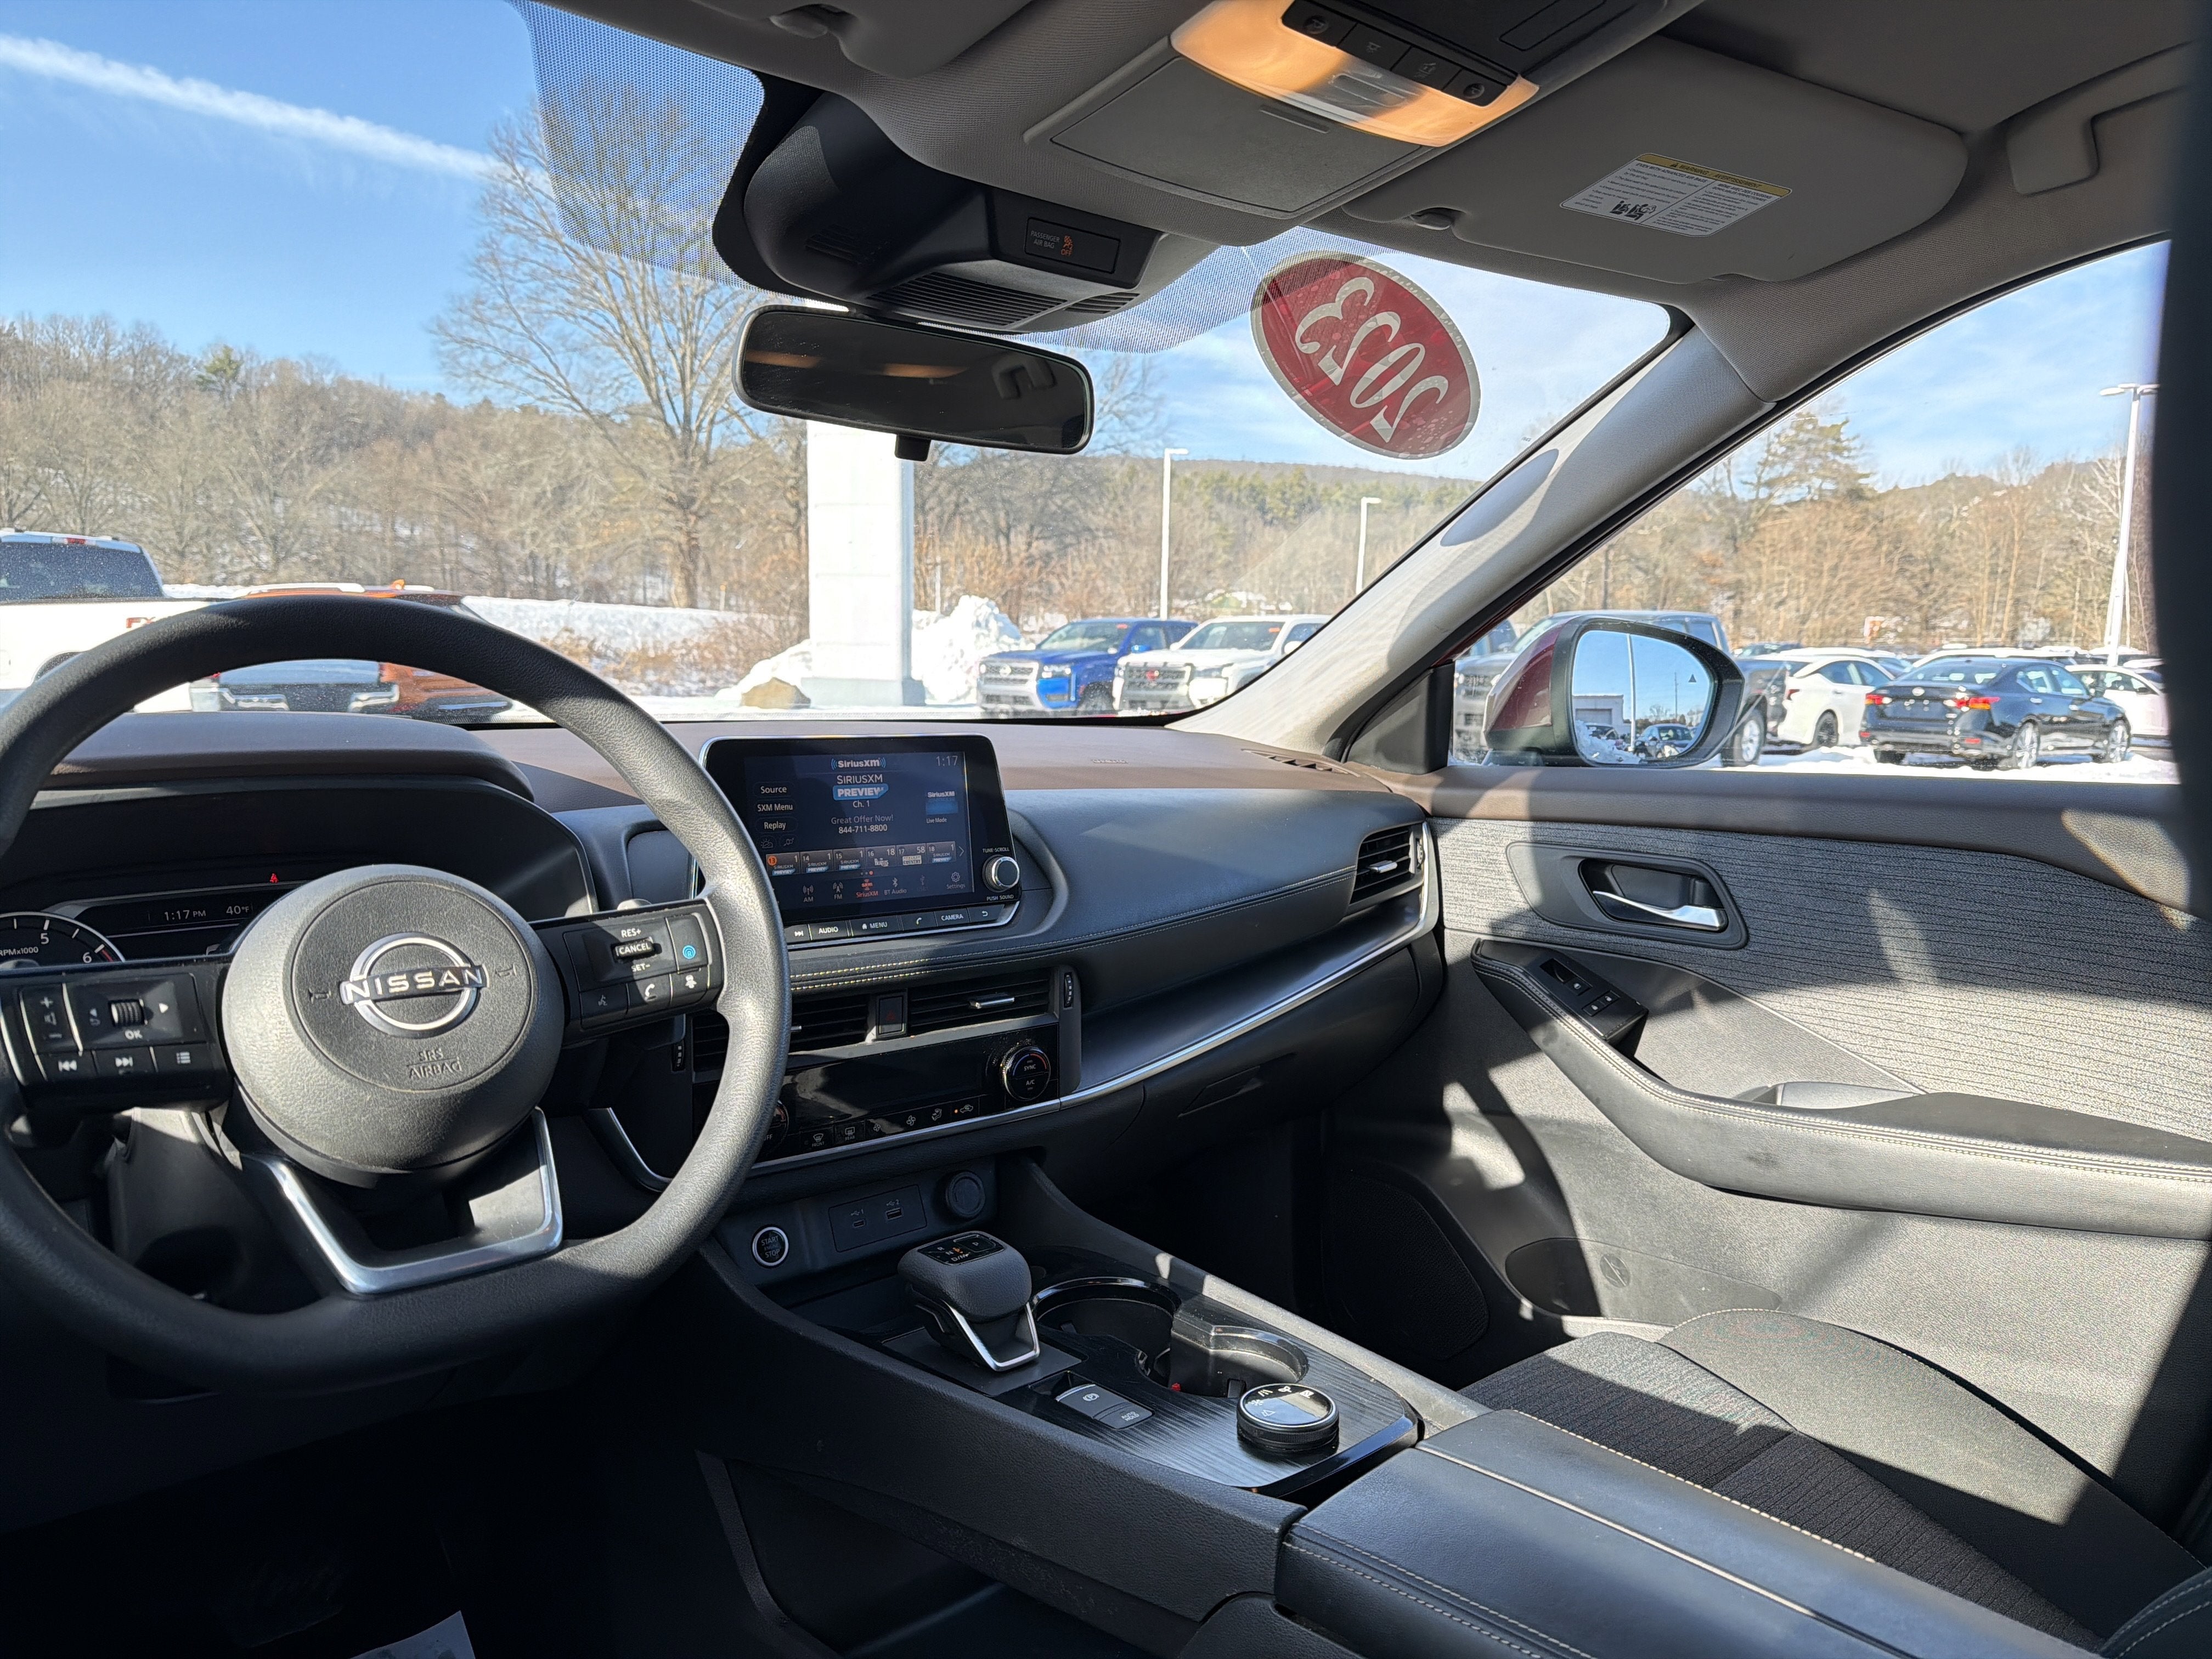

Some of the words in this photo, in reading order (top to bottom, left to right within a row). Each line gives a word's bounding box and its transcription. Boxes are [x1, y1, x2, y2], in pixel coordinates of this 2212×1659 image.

[1031, 230, 1060, 242] PASSENGER
[936, 755, 958, 766] 1:17
[837, 774, 883, 785] SIRIUSXM
[760, 786, 787, 794] Source
[837, 787, 884, 797] PREVIEW
[757, 804, 773, 812] SXM
[774, 803, 793, 811] Menu
[853, 800, 865, 808] Ch.
[831, 816, 852, 825] Great
[853, 815, 873, 823] Offer
[764, 822, 786, 831] Replay
[838, 824, 888, 834] 844-711-8800
[165, 910, 190, 921] 1:17
[941, 913, 964, 922] CAMERA
[818, 926, 839, 934] AUDIO
[870, 921, 888, 929] MENU
[620, 928, 641, 938] RES+
[40, 933, 50, 945] 5
[618, 942, 651, 955] CANCEL
[82, 952, 92, 963] 6
[346, 968, 482, 1002] NISSAN
[125, 1029, 143, 1040] OK
[418, 1048, 444, 1062] SRS
[409, 1059, 462, 1079] AIRBAG
[761, 1235, 778, 1246] START
[765, 1249, 780, 1259] STOP
[1121, 1411, 1136, 1419] AUTO
[1125, 1413, 1140, 1421] HOLD
